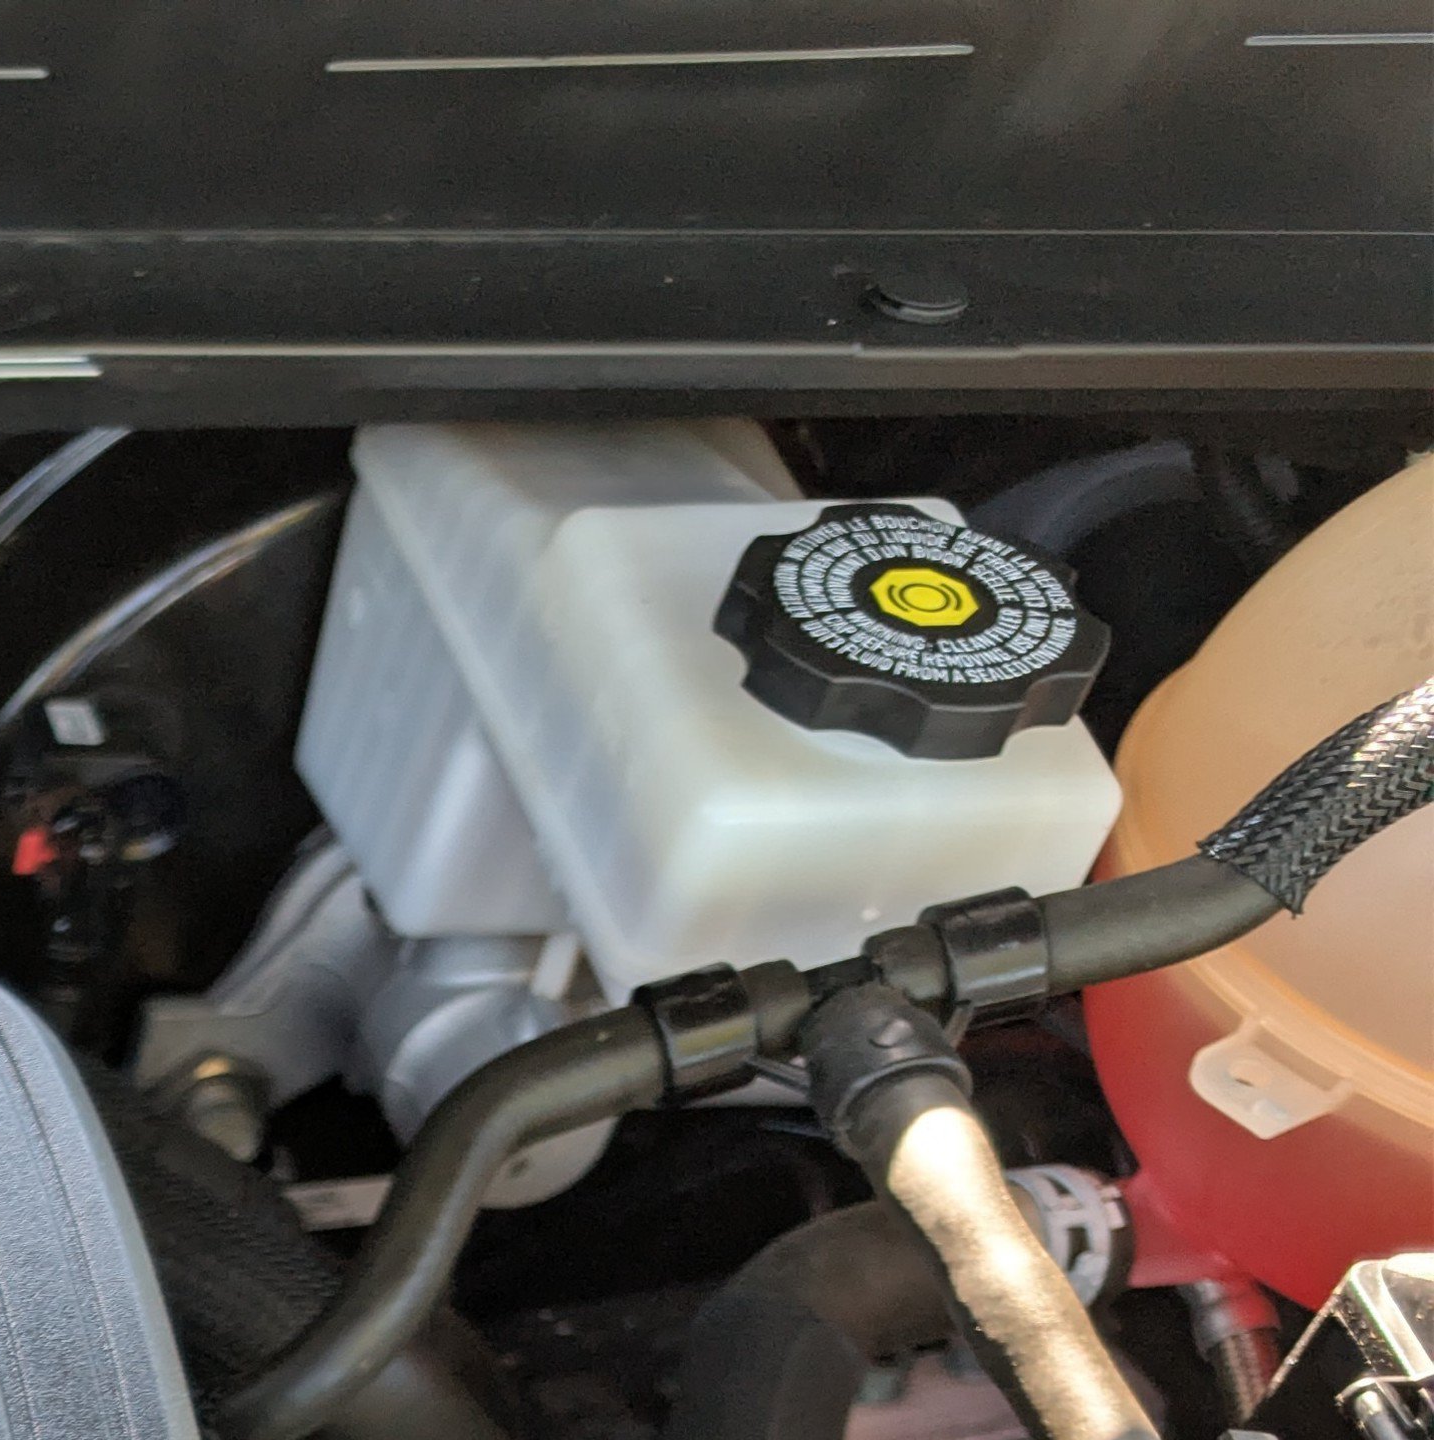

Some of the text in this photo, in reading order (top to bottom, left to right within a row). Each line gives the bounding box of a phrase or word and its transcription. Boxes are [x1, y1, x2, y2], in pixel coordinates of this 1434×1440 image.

[841, 516, 871, 532] LE
[867, 515, 957, 537] BOUCHON
[956, 527, 1016, 557] AVANT
[1006, 553, 1041, 571] LA
[847, 530, 881, 547] DU
[877, 529, 949, 549] LIQUIDE
[949, 539, 979, 558] DE
[973, 550, 1027, 581] FREIN
[818, 612, 860, 637] CAP
[936, 634, 999, 653] CLEAN
[983, 606, 1022, 643] FILLER
[1020, 609, 1050, 639] ONLY
[834, 641, 894, 671] FLUID
[892, 661, 951, 683] FROM
[948, 670, 968, 683] A
[963, 660, 1037, 683] SEALED
[845, 630, 919, 664] BEFORE
[1004, 632, 1043, 656] USE
